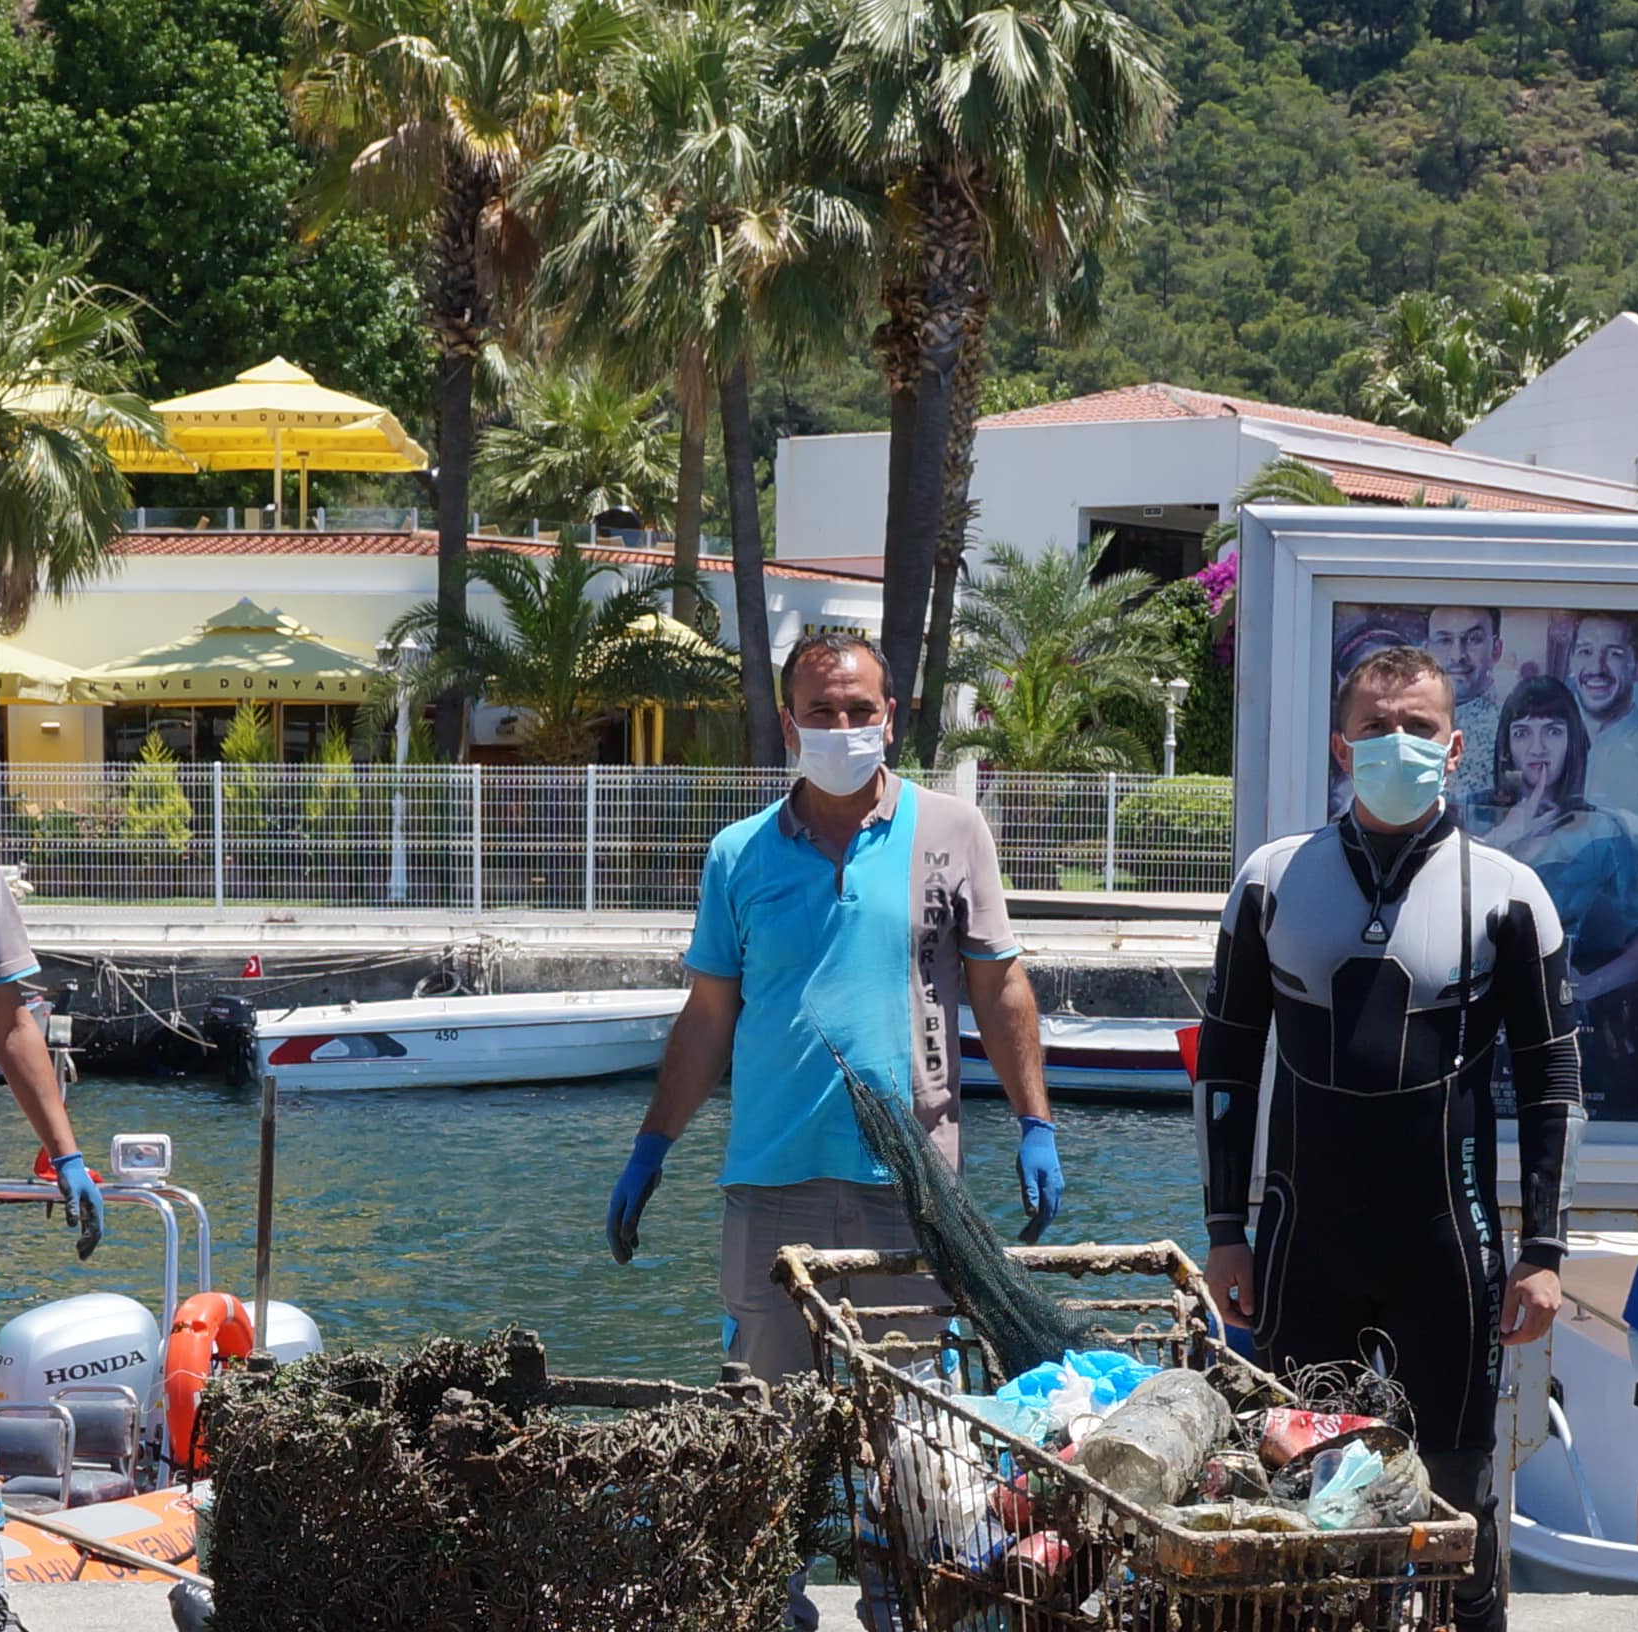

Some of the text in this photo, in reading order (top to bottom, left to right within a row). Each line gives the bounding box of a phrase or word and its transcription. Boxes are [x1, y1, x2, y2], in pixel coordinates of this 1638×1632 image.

[87, 675, 368, 693] KAHVE DÜNYASI
[434, 1030, 460, 1042] 450
[43, 1349, 148, 1386] HONDA
